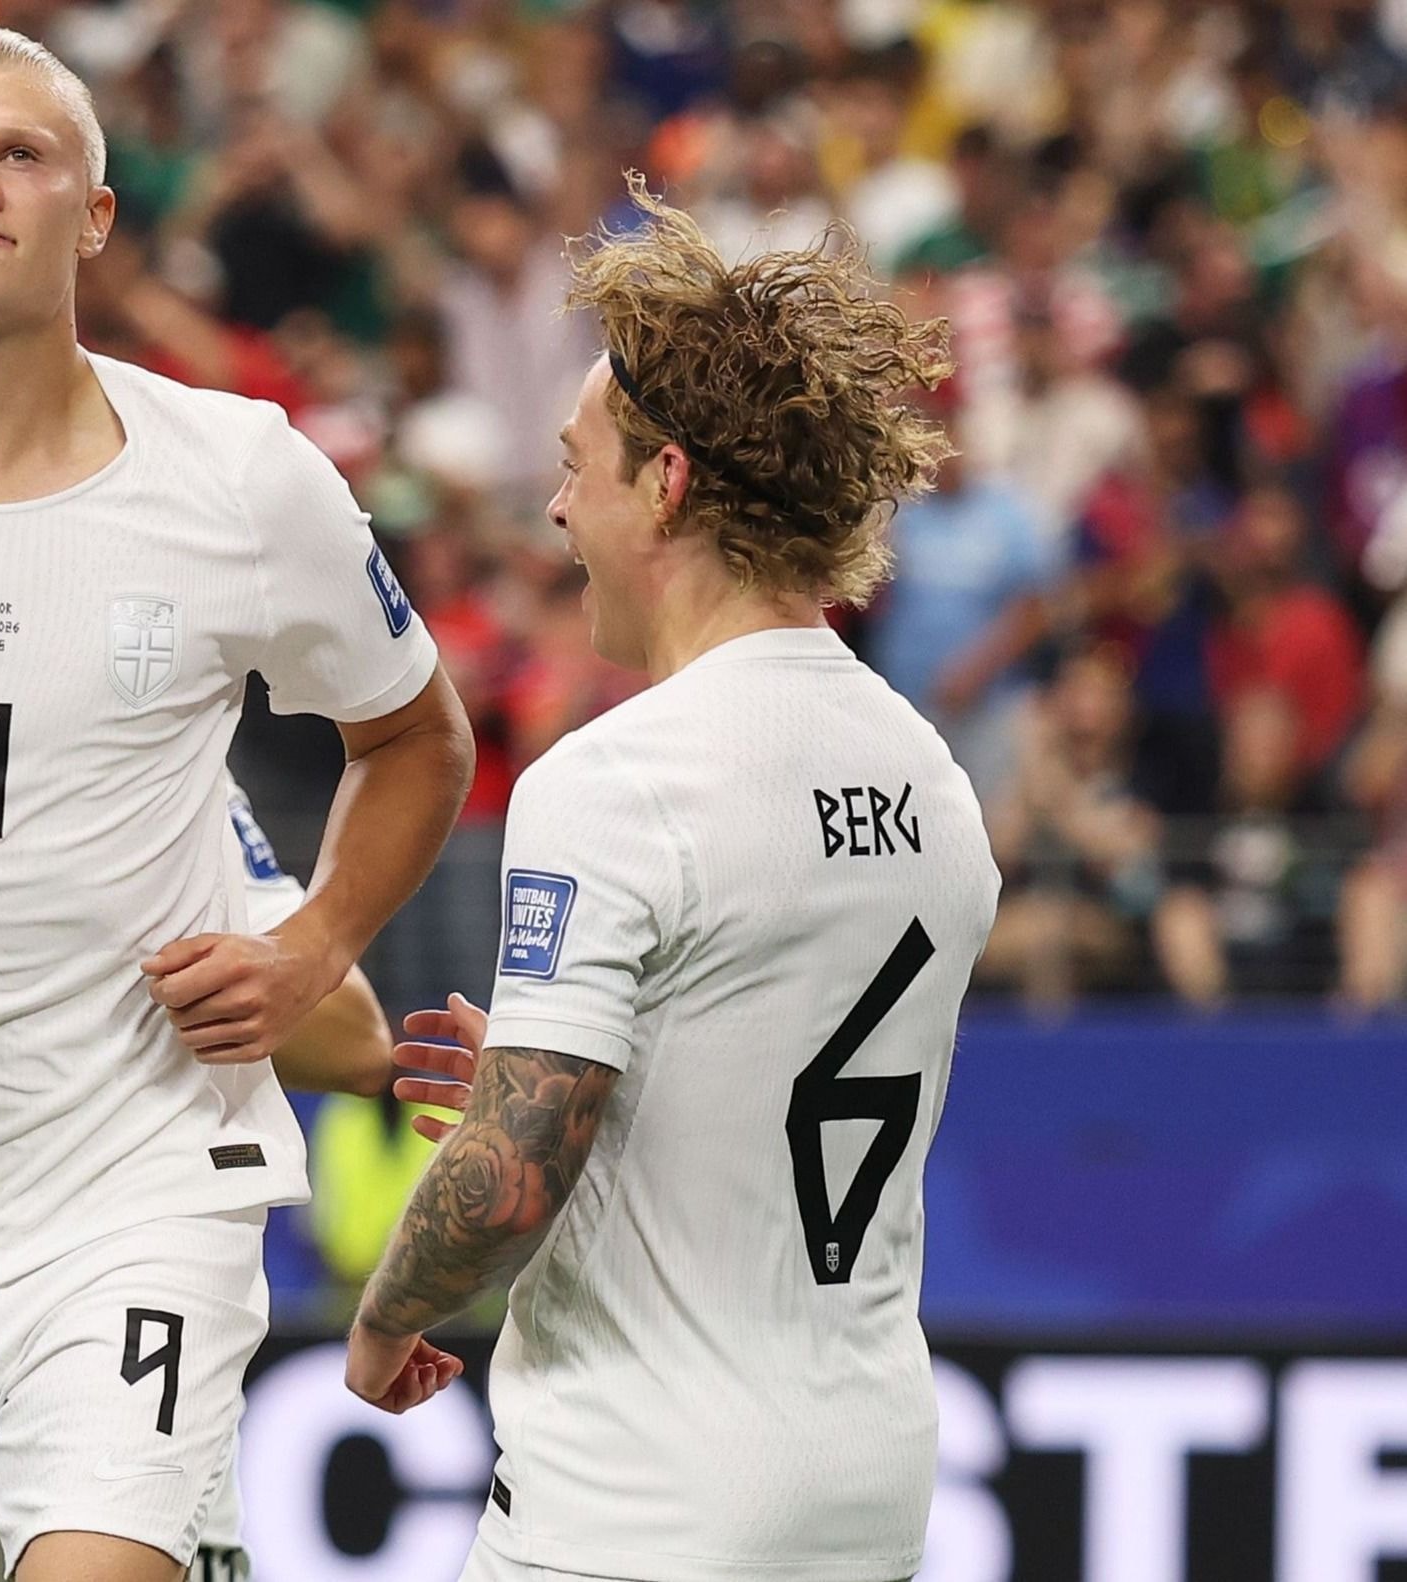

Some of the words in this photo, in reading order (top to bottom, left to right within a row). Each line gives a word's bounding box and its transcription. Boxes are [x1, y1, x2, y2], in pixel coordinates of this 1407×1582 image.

[813, 781, 922, 858] BERG
[512, 903, 555, 930] UNITES
[513, 887, 557, 908] FOOTBALL
[517, 928, 554, 951] World
[785, 915, 936, 1285] 6
[120, 1307, 184, 1436] 9
